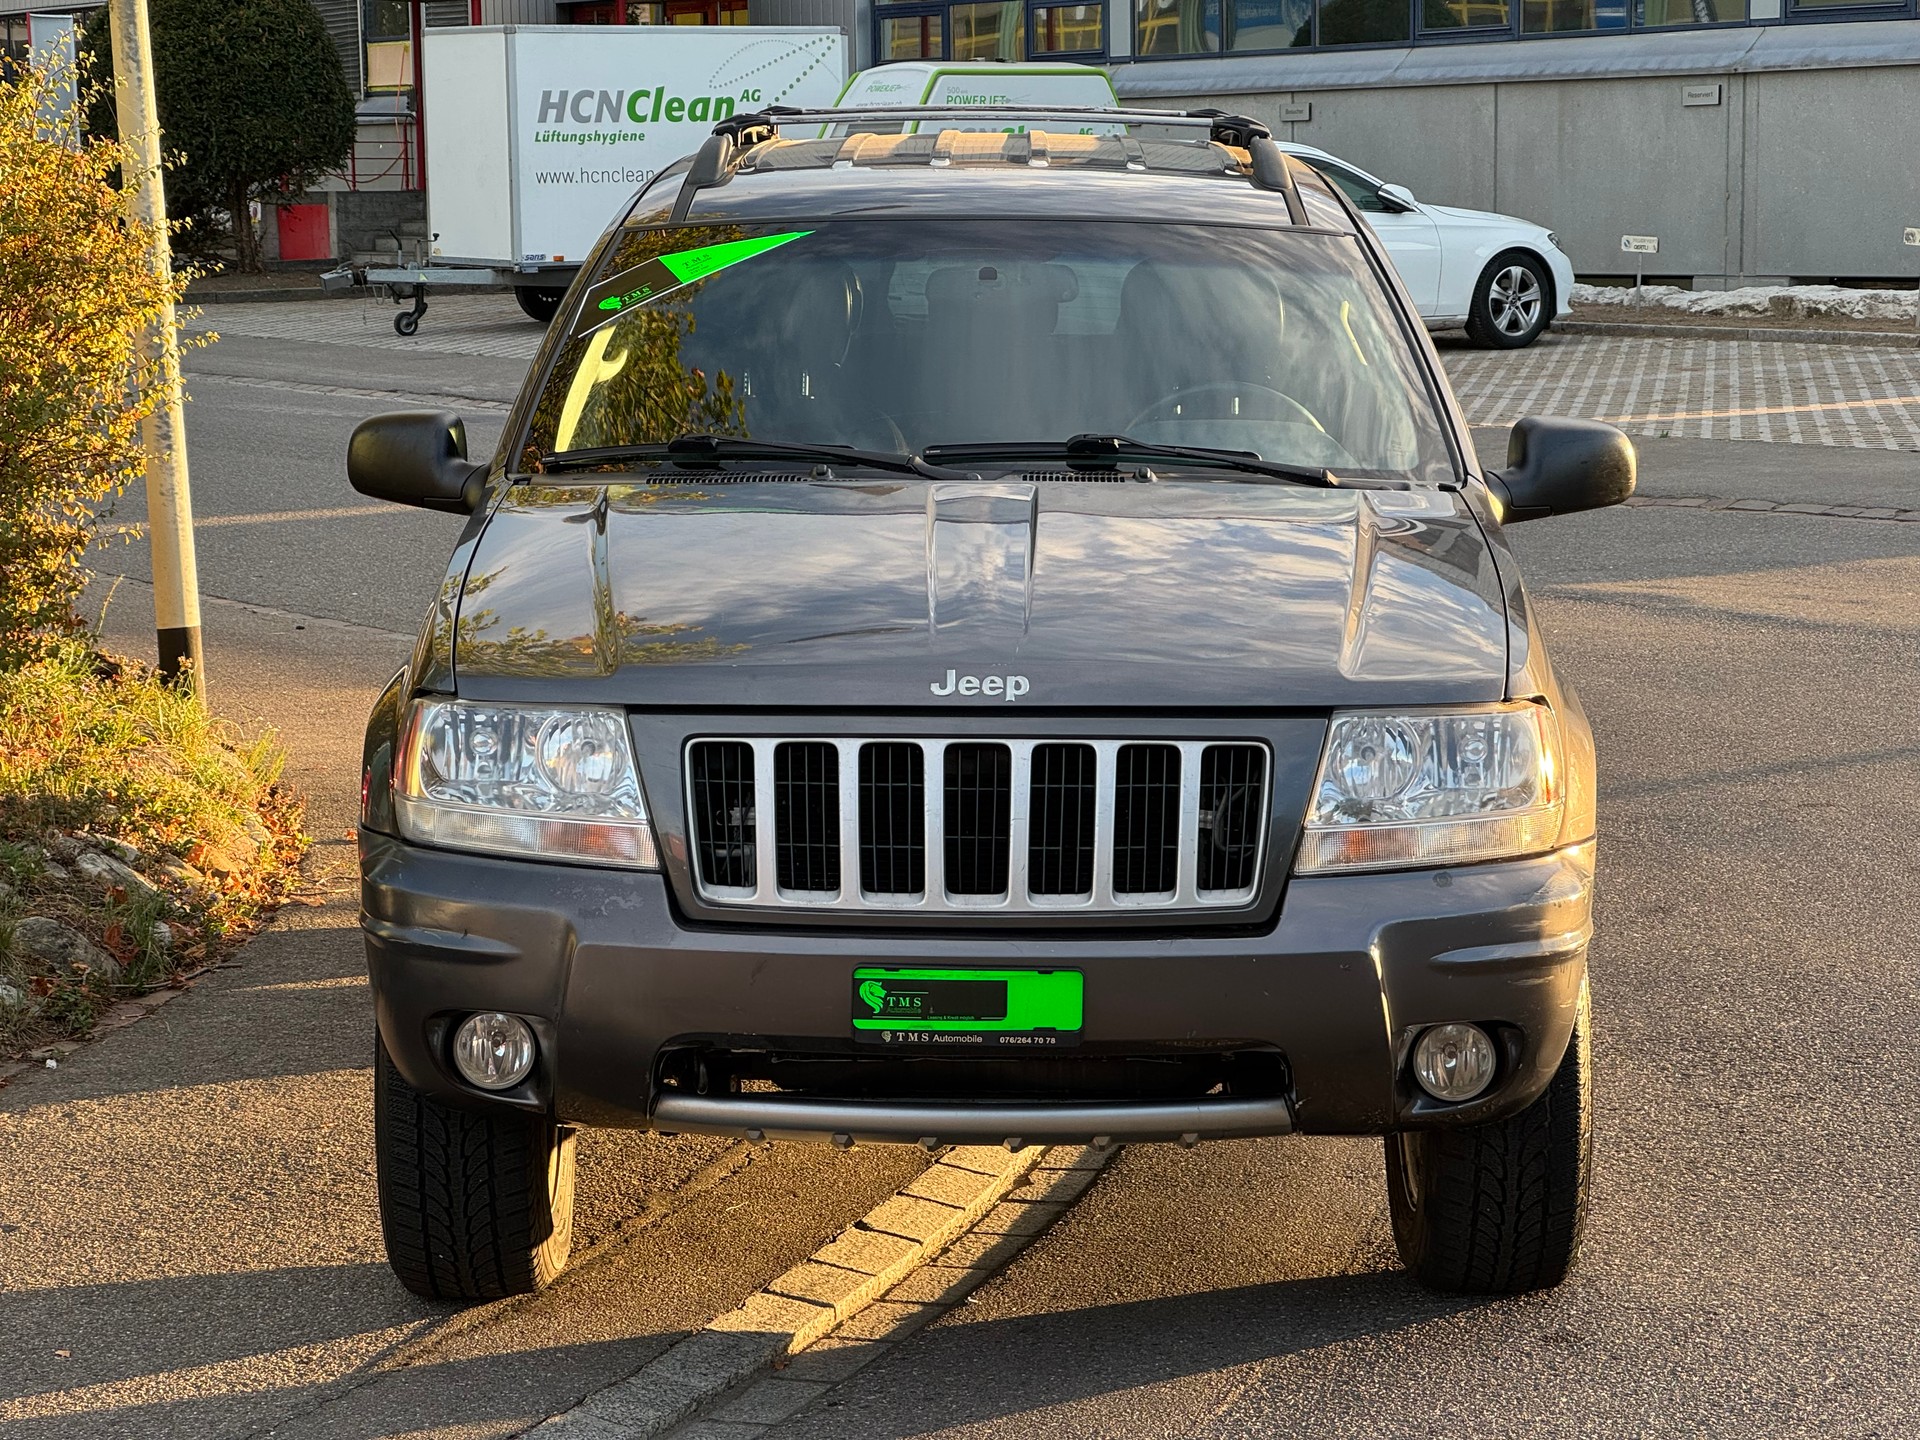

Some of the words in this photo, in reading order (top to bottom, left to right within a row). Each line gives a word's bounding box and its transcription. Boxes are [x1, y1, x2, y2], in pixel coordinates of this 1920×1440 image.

[537, 86, 735, 123] HCNClean
[740, 89, 761, 102] AG
[534, 129, 645, 145] Lüftungshygiene
[930, 669, 1030, 702] Jeep
[932, 1034, 983, 1043] Automobile
[1000, 1036, 1032, 1044] 076/264
[1034, 1036, 1044, 1044] 70
[1046, 1036, 1056, 1044] 78
